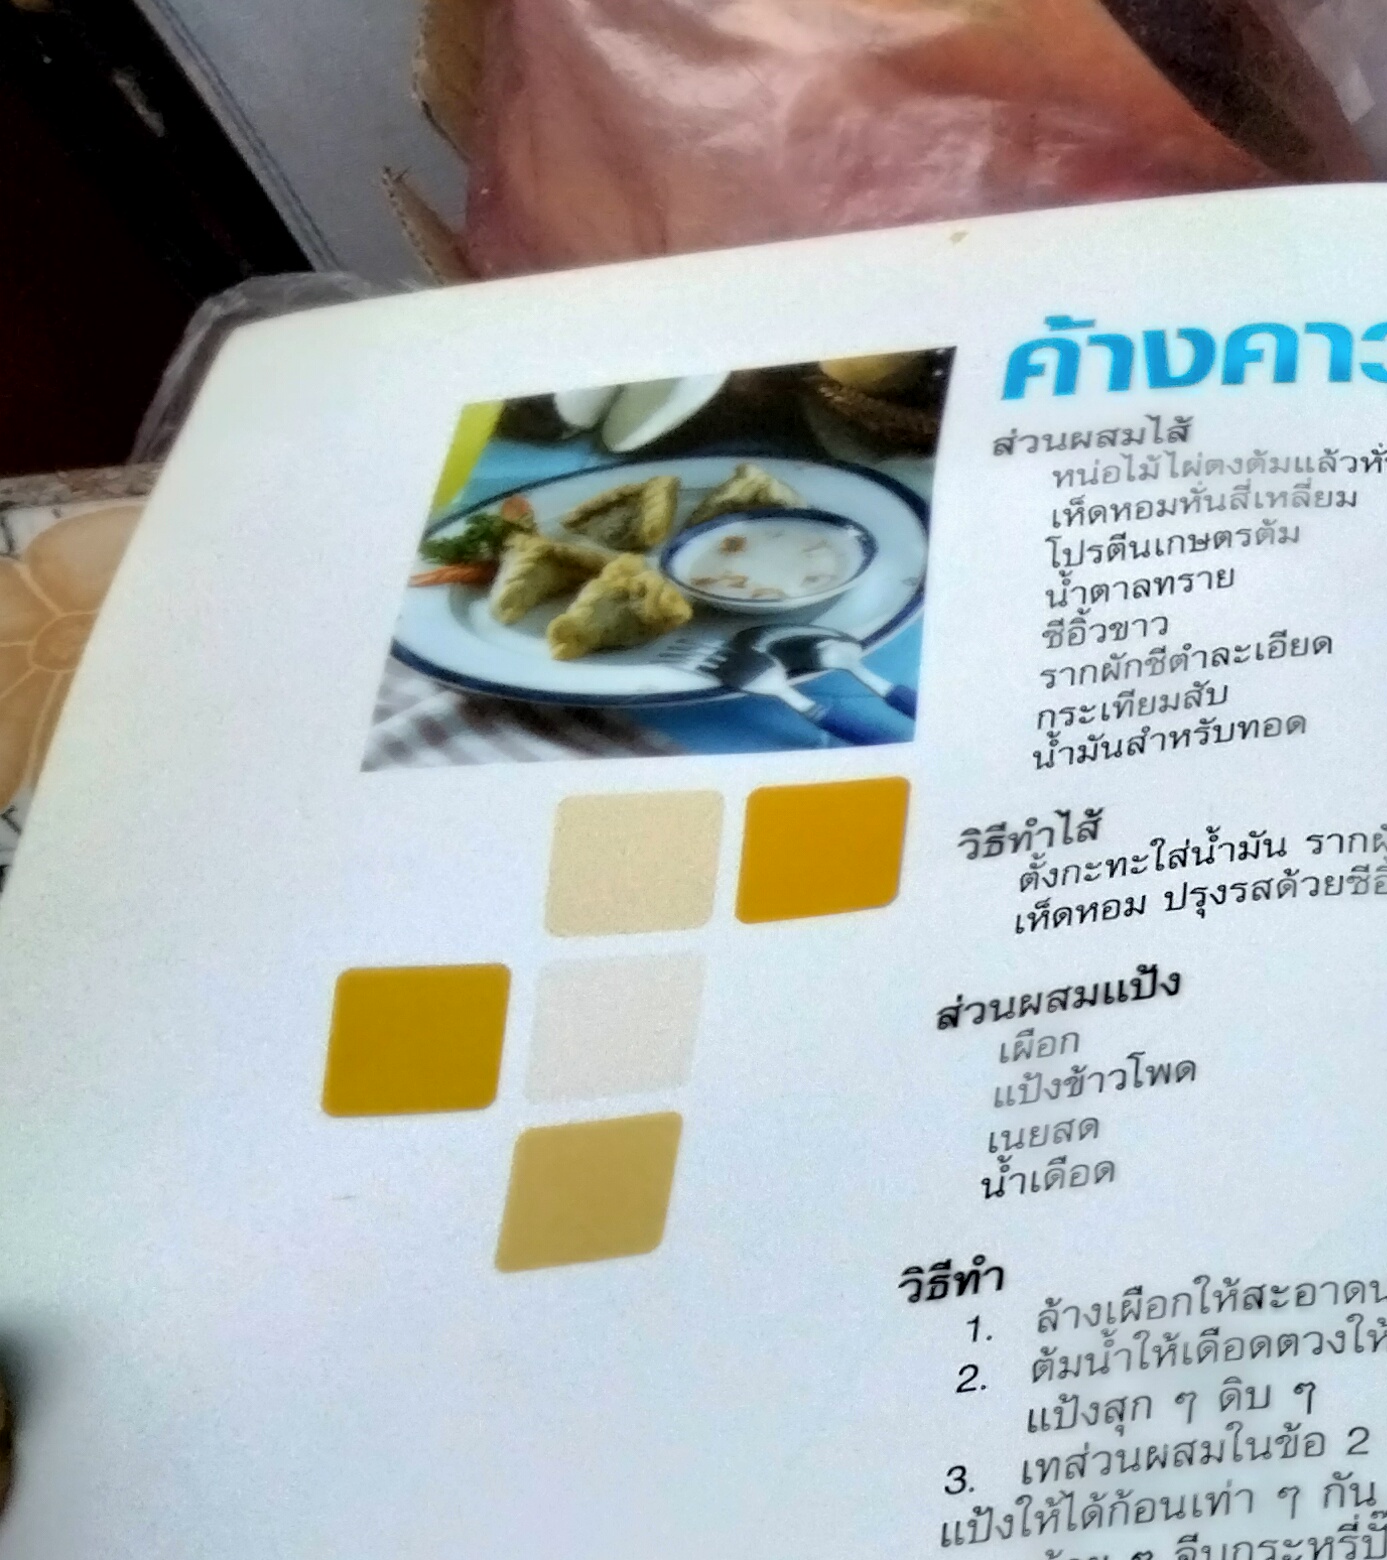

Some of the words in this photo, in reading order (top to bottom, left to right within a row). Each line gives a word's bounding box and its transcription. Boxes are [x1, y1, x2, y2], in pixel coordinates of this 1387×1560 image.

[992, 415, 1193, 456] ส่วนผสมไส้
[1051, 478, 1358, 529] เห็ดหอมหั่นสี่เหลี่ยม
[1046, 521, 1300, 569] โปรตีนเกษตรต้ม
[1046, 563, 1236, 609] น้ำตาลทราย
[1040, 629, 1333, 690] รากผักชีตำละเอียด
[1036, 680, 1229, 731] กระเทียมสับ
[1032, 711, 1307, 770] น้ำมันสำหรับทอด
[957, 806, 1105, 861] วิธีทำไส้
[1018, 825, 1287, 892] ตั้งกะทะใส่น้ำมัน
[1015, 891, 1147, 935] เห็ดหอม
[936, 964, 1182, 1031] ส่วนผสมแป้ง
[999, 1027, 1081, 1064] เผือก
[993, 1051, 1198, 1109] แป้งข้าวโพด
[988, 1116, 1101, 1154] เนยสด
[981, 1155, 1116, 1201] น้ำเดือด
[898, 1253, 1005, 1304] วิธีทำ
[965, 1315, 993, 1343] 1.
[955, 1364, 988, 1394] 2.
[1026, 1391, 1153, 1437] แป้งสุก
[1218, 1376, 1272, 1413] ดิบ
[944, 1465, 975, 1496] 3.
[1021, 1421, 1326, 1485] เทส่วนผสมในข้อ
[1346, 1427, 1370, 1455] 2
[940, 1480, 1254, 1549] แป้งให้ได้ก้อนเท่า
[1323, 1471, 1378, 1509] กัน
